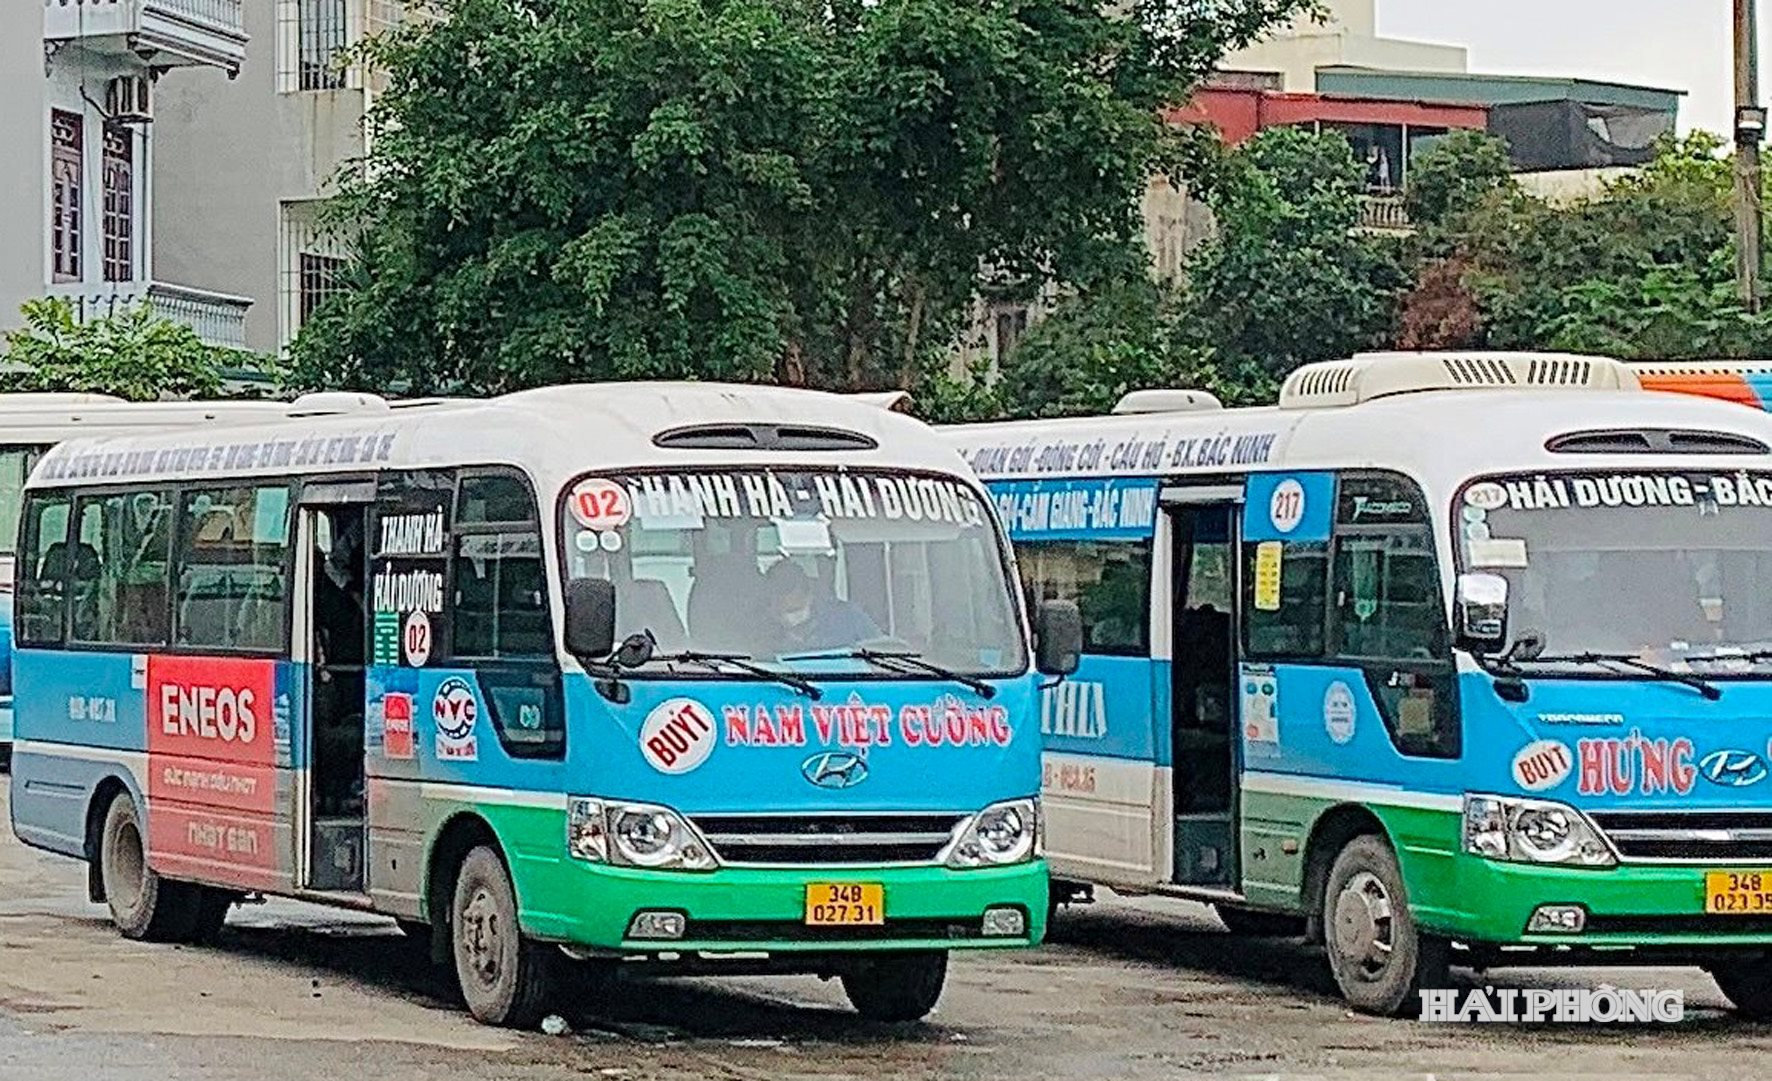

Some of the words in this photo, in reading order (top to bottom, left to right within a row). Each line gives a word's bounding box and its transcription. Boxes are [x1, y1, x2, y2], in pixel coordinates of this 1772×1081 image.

[579, 489, 623, 518] 02
[741, 466, 794, 517] HÀ
[1275, 492, 1299, 519] 217
[1506, 475, 1570, 509] HẢI
[380, 515, 424, 554] THANH
[408, 624, 427, 654] 02
[160, 684, 256, 743] ENEOS
[723, 706, 806, 747] NAM
[810, 691, 893, 757] VIỆT
[829, 885, 862, 903] 34B
